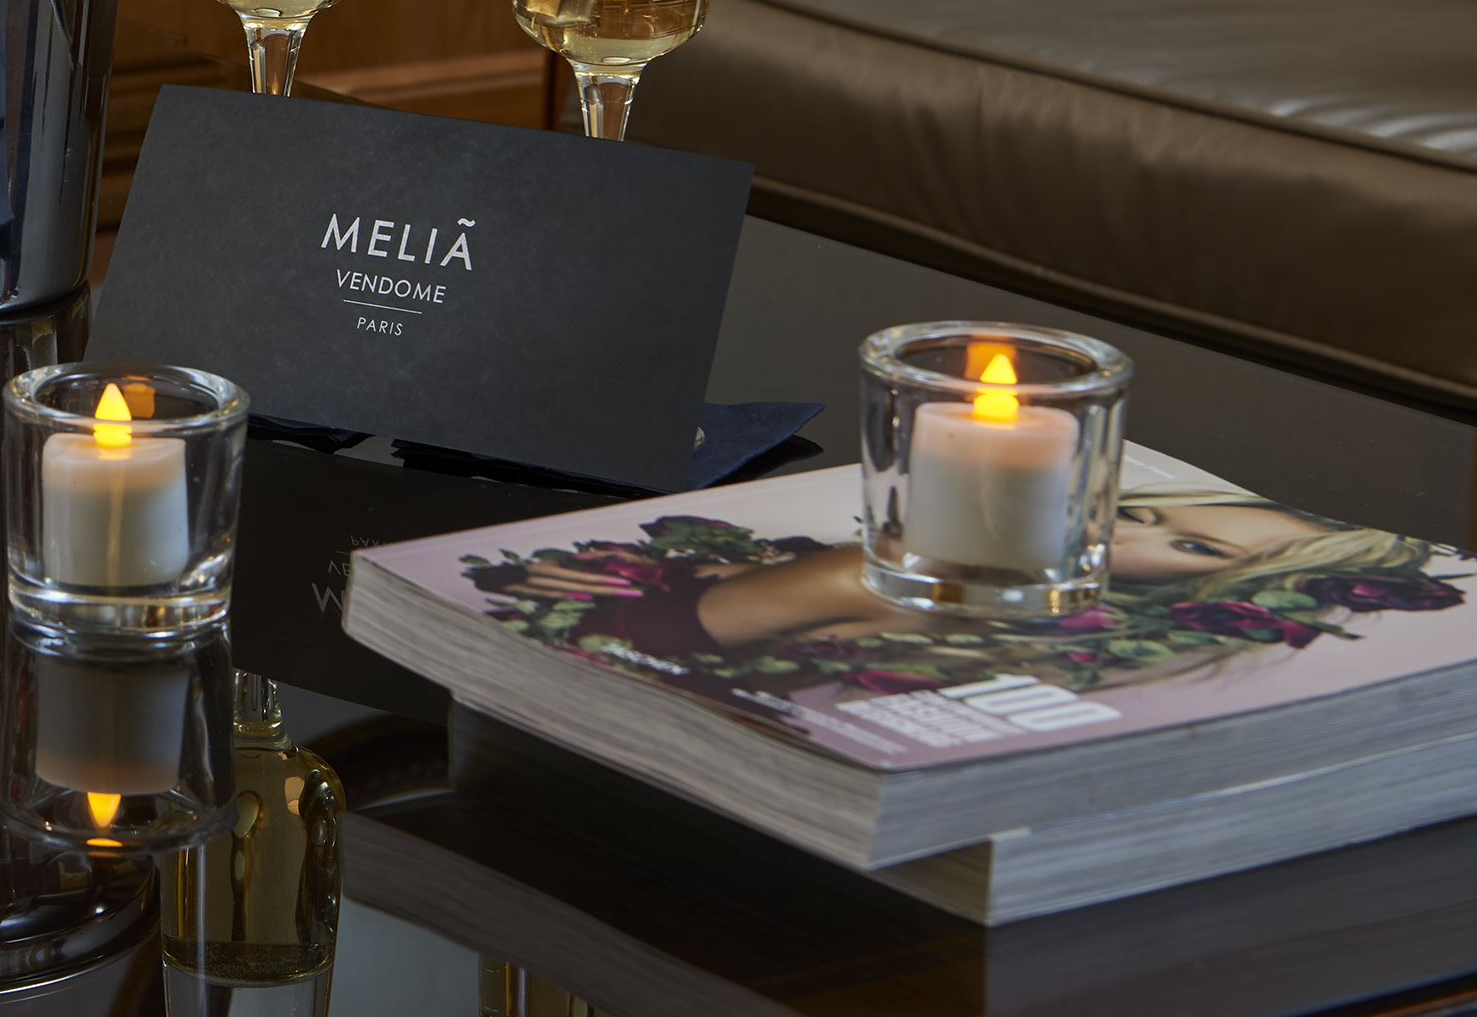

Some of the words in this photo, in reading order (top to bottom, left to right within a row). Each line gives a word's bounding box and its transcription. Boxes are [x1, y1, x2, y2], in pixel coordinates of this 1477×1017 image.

[320, 213, 476, 271] MELIÃ
[336, 269, 446, 304] VENDOME
[356, 316, 403, 337] PARIS
[937, 673, 1122, 732] 100
